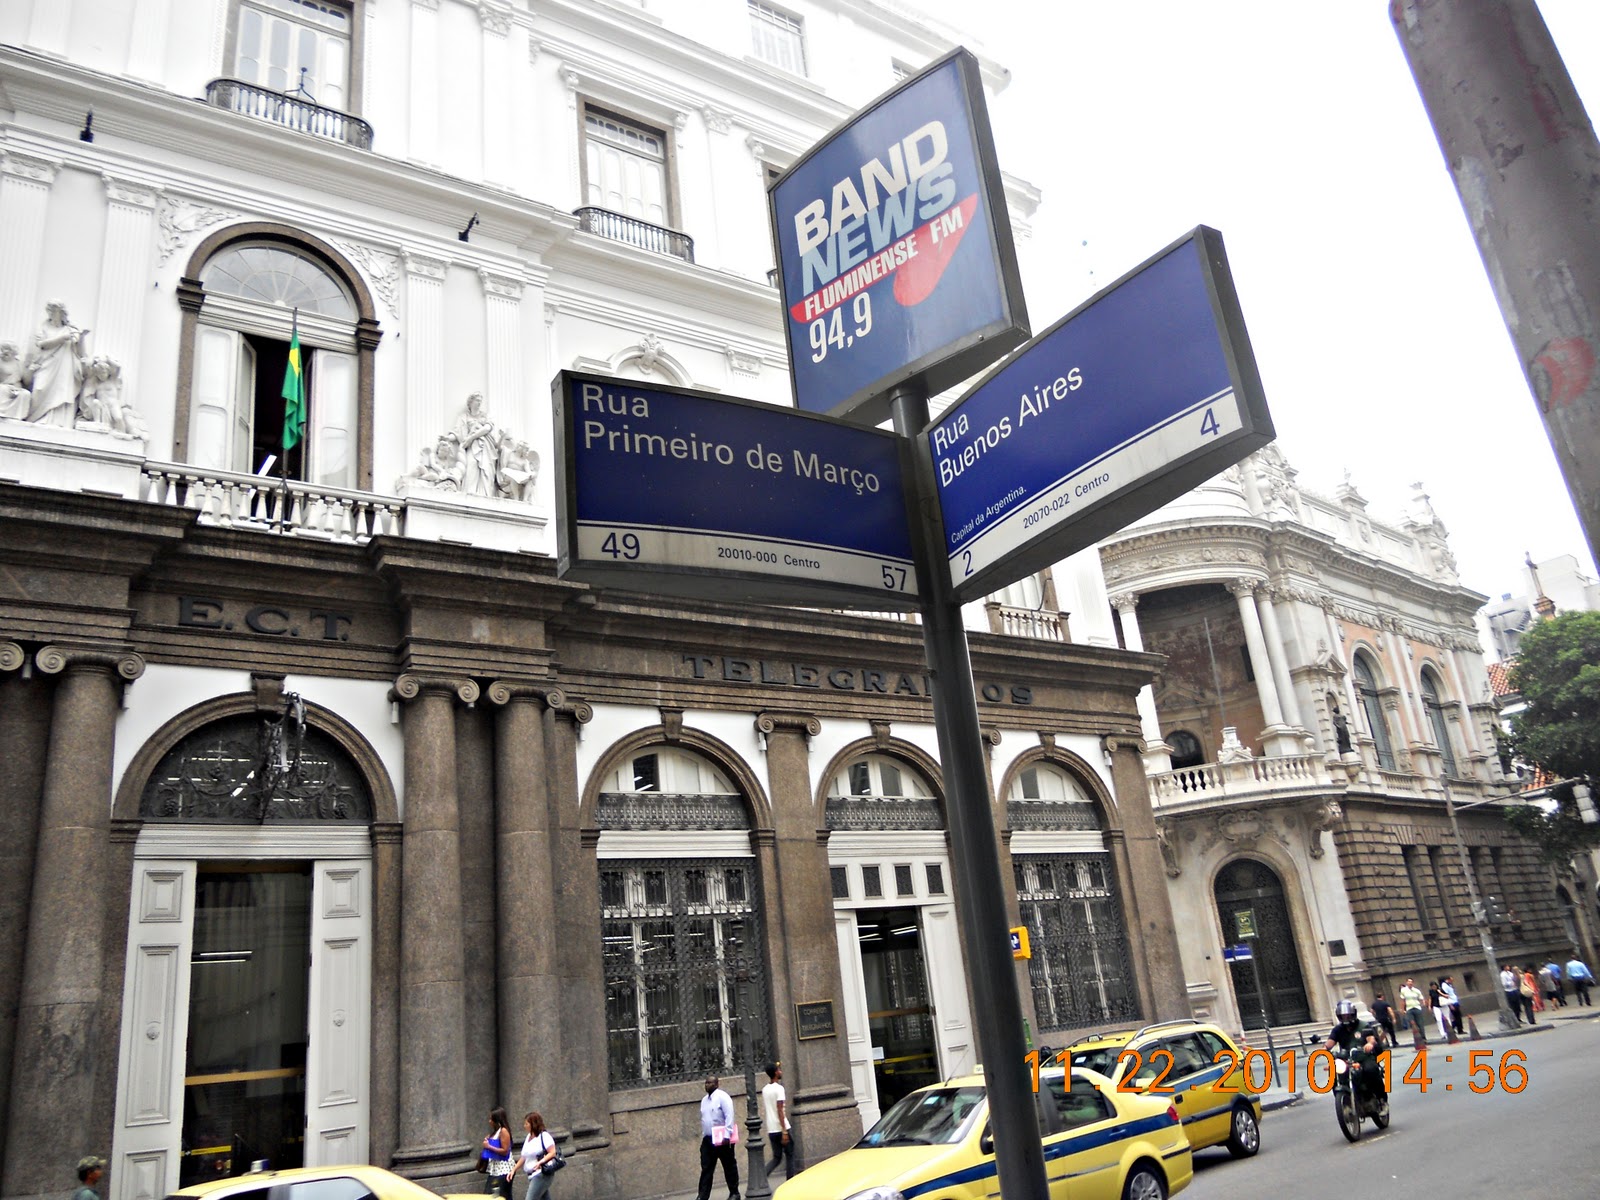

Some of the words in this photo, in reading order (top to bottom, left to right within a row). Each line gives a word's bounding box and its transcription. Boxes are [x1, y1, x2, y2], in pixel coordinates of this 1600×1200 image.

[794, 120, 949, 257] BAND
[802, 162, 956, 297] NEWS
[804, 234, 919, 321] FLUMINENSE
[929, 206, 964, 245] FM
[808, 291, 873, 364] 94,9
[581, 383, 650, 419] Rua
[933, 412, 970, 456] Rua
[938, 415, 1012, 488] Buenos
[1018, 365, 1083, 427] Aires
[584, 420, 734, 466] Primeiro
[746, 443, 784, 473] de
[793, 449, 880, 496] Março
[962, 550, 974, 577] 2
[1022, 492, 1071, 529] 20070-022
[1074, 472, 1110, 498] Centro
[1199, 407, 1220, 436] 4
[951, 518, 975, 544] Capital
[974, 513, 985, 525] da
[985, 485, 1028, 518] Argentina.
[601, 532, 641, 560] 49
[717, 546, 778, 565] 20010-000
[783, 554, 821, 570] Centro
[881, 564, 907, 592] 57
[682, 654, 1034, 705] TELEGRAOS
